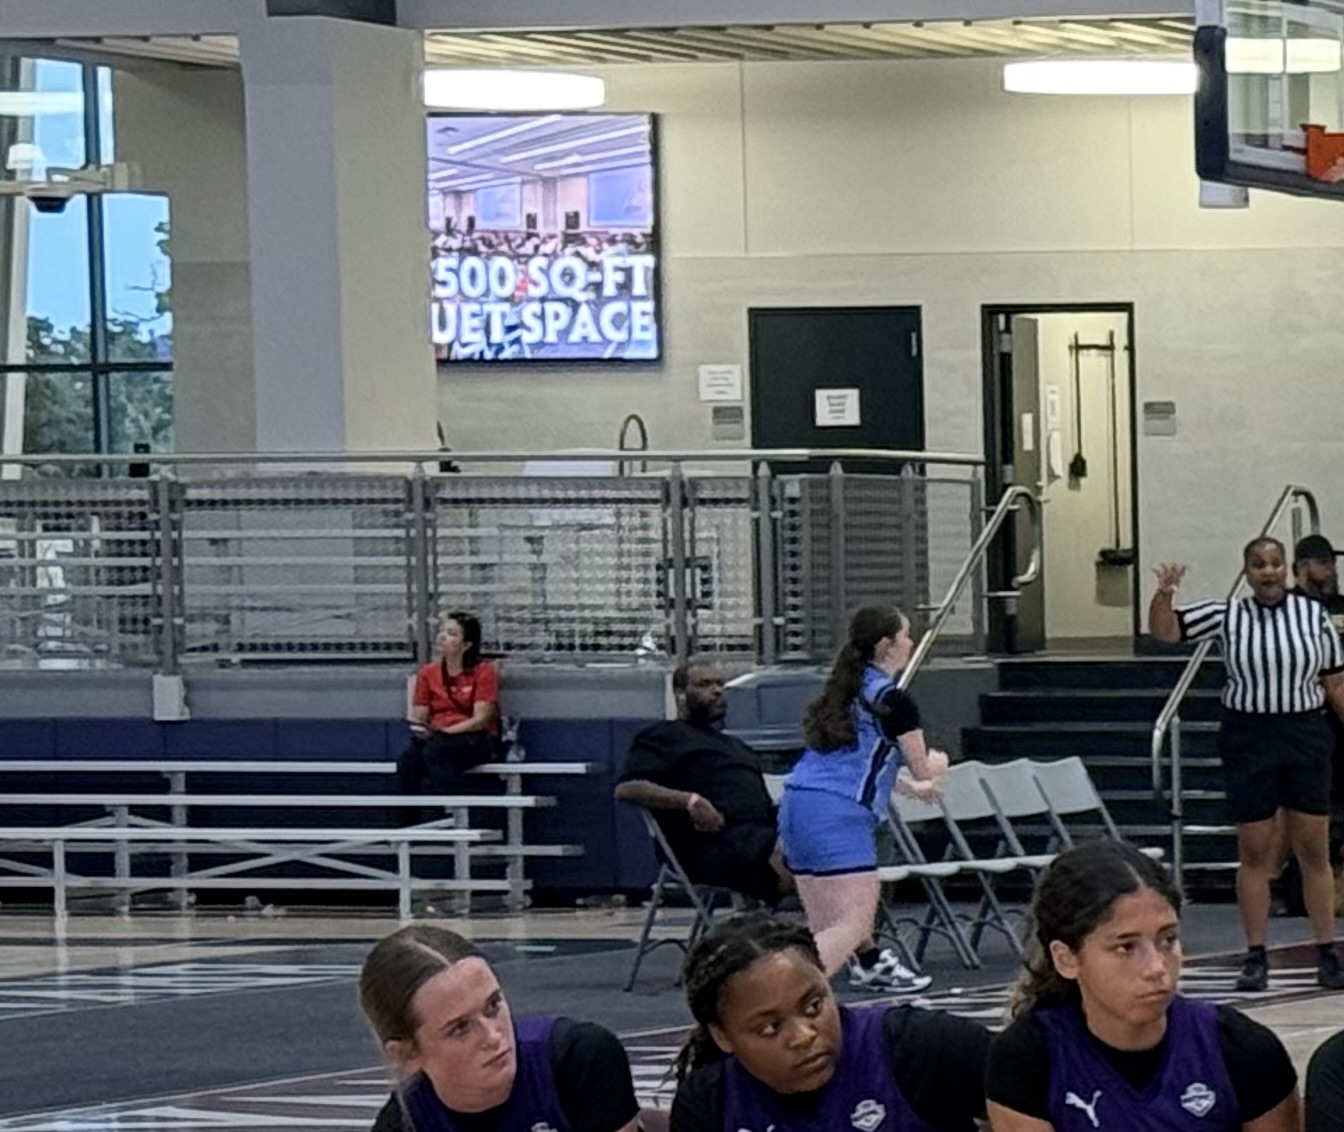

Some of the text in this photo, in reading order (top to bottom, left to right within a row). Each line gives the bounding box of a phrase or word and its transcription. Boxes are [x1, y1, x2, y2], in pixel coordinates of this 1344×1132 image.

[431, 255, 655, 300] 500 SQ-FT
[432, 301, 655, 344] UET SPACE
